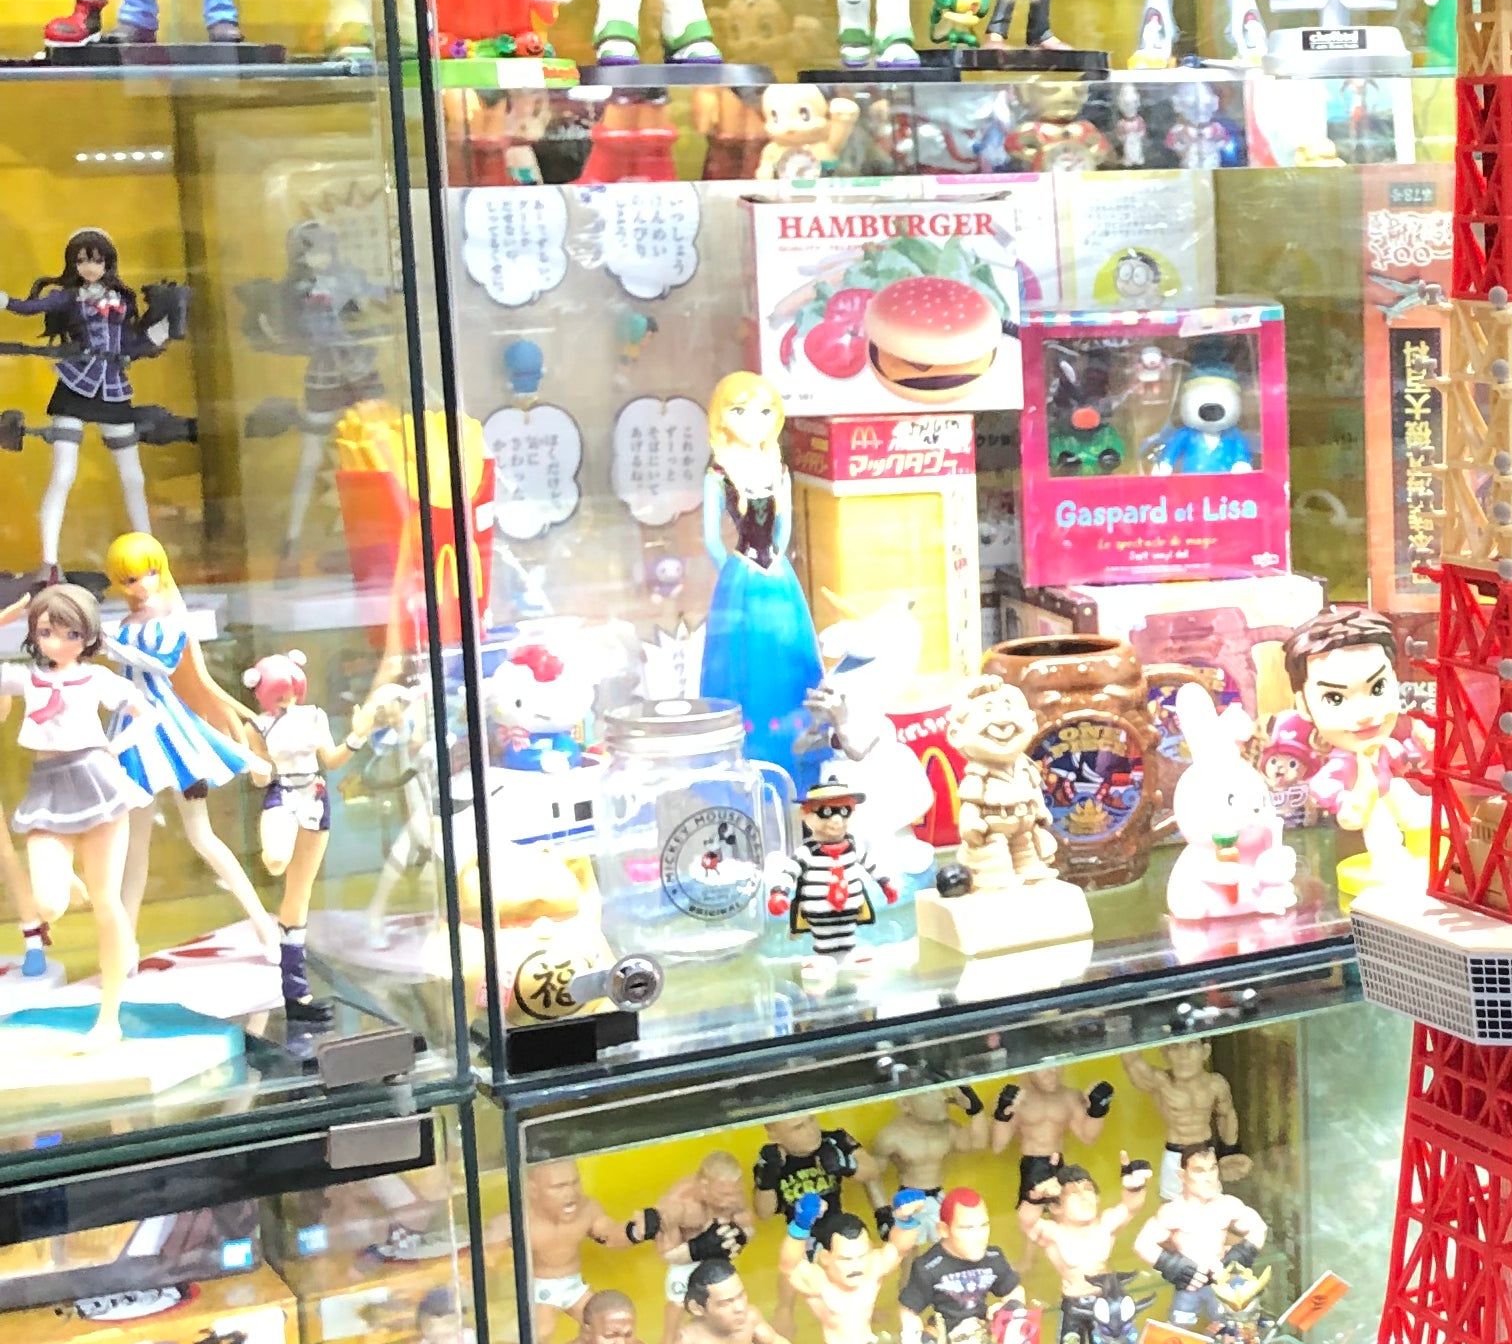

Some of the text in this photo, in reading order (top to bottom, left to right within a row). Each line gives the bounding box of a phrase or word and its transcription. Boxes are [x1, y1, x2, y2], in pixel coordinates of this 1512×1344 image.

[777, 212, 997, 240] HAMBURGER
[1055, 495, 1168, 534] Gaspard
[1202, 495, 1258, 522] Lisa
[665, 810, 742, 883] MICKEY MOUSE
